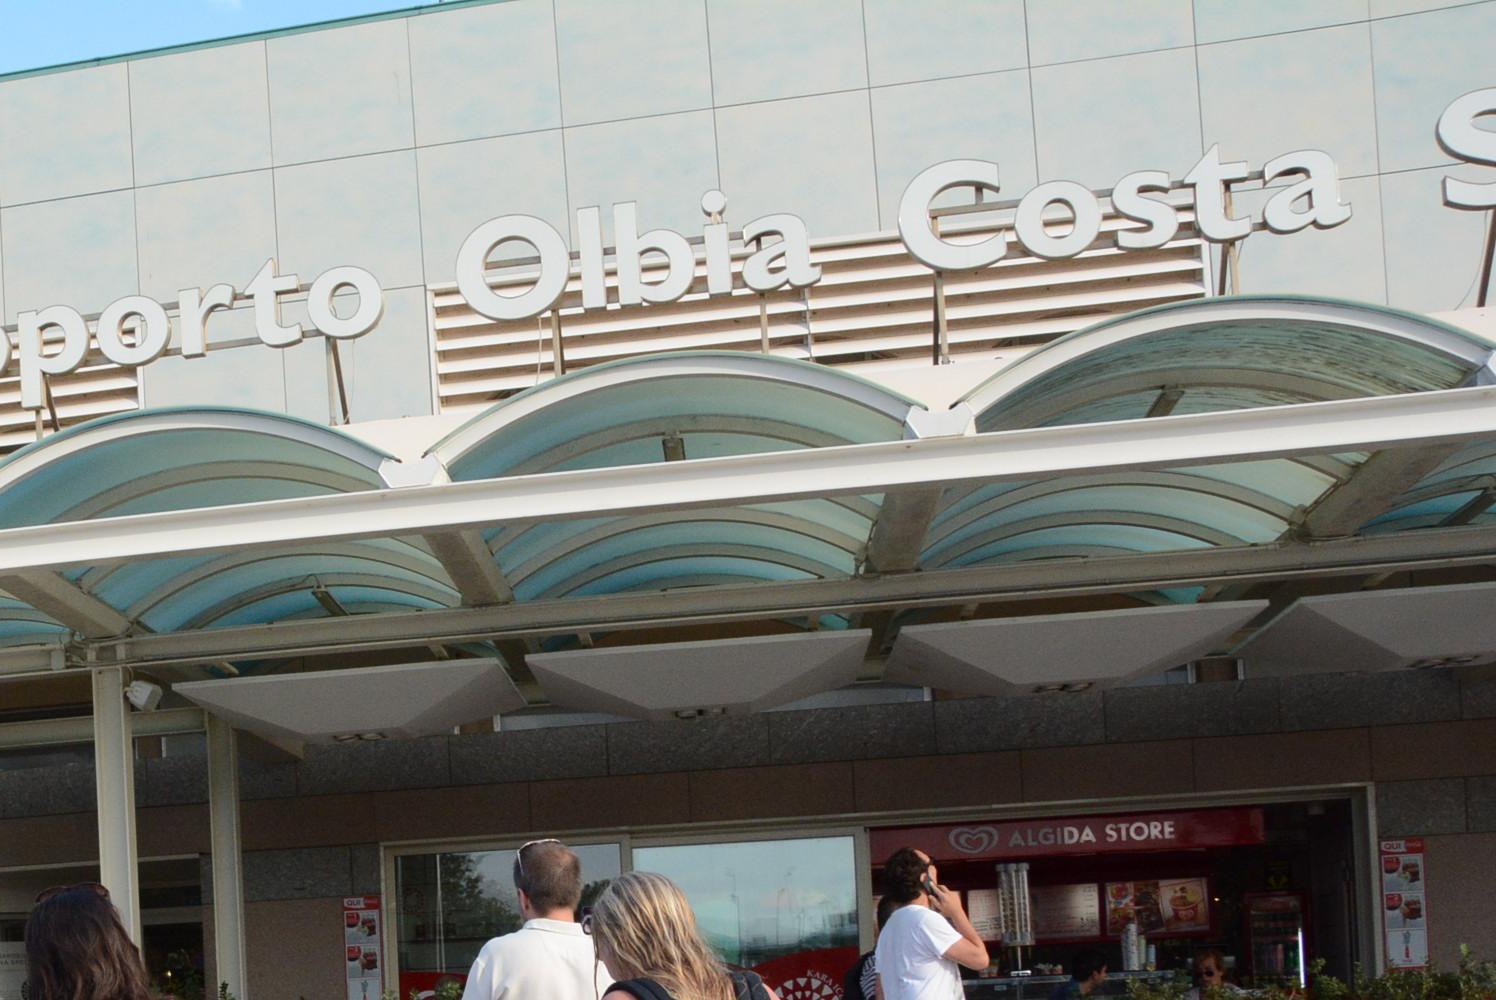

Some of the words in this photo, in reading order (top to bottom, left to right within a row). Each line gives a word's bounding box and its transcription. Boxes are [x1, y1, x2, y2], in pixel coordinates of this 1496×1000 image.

[455, 189, 822, 320] Olbia
[897, 143, 1352, 272] Costa
[1105, 820, 1176, 842] STORE
